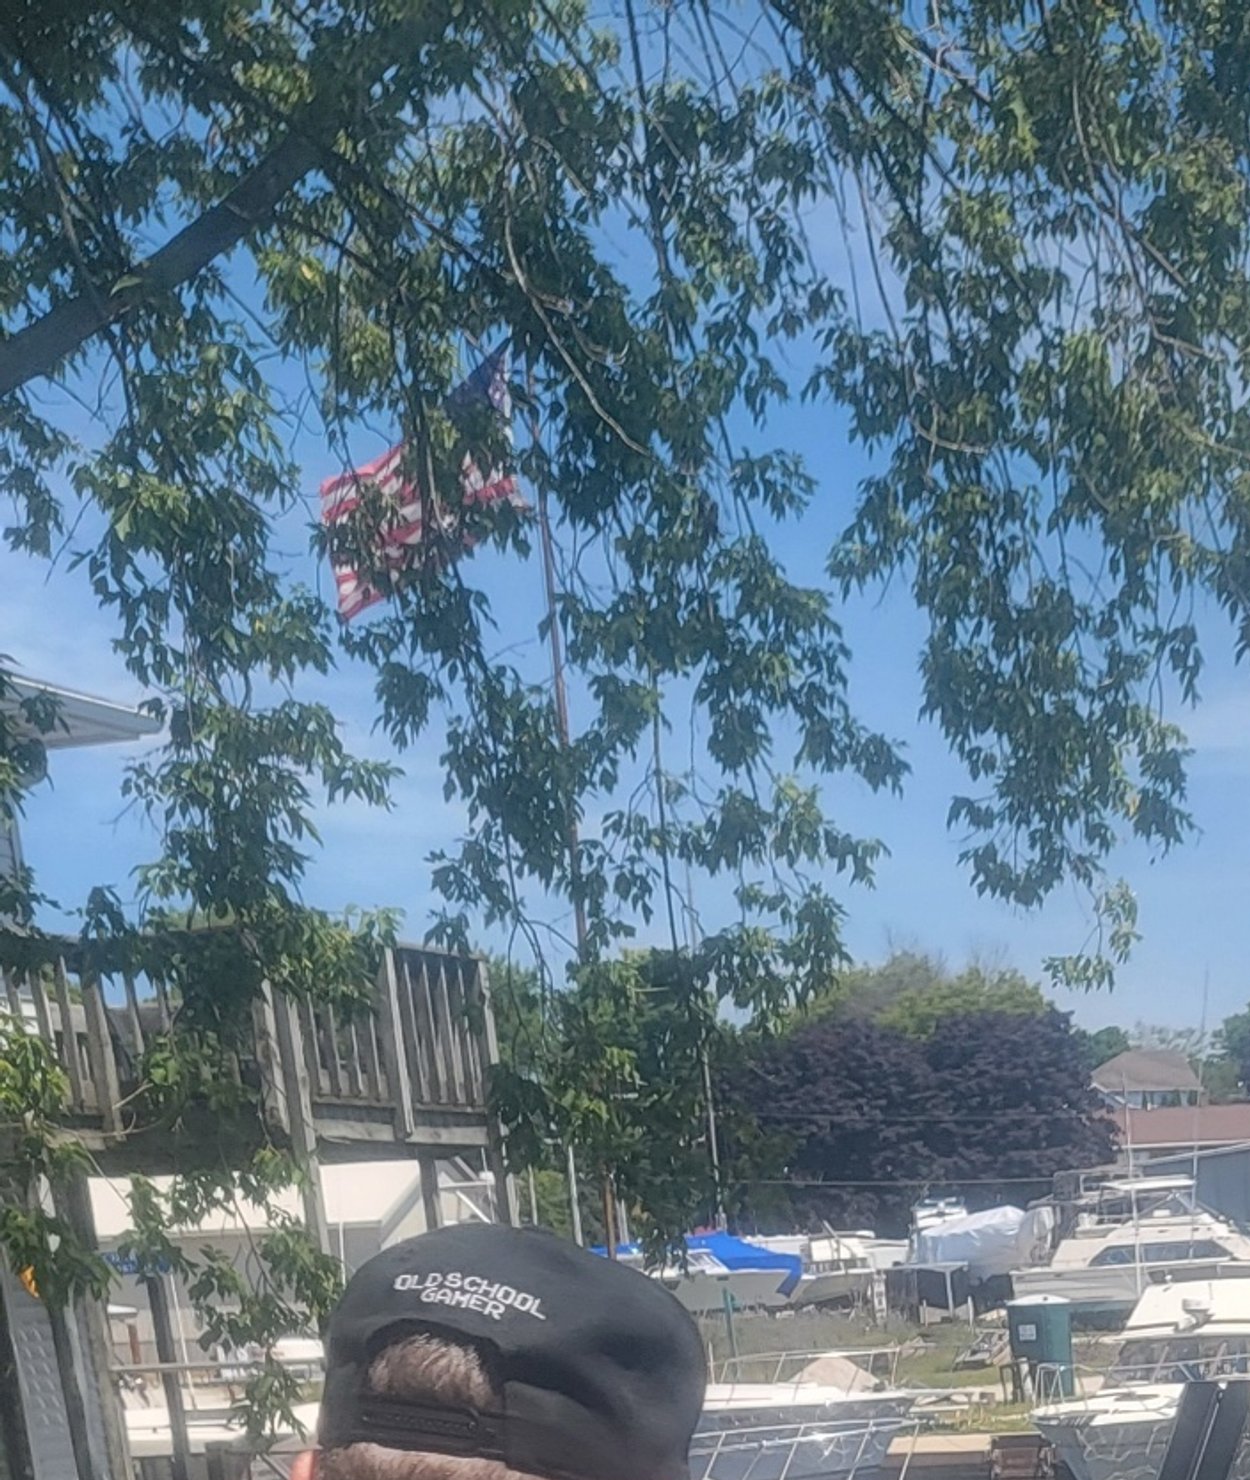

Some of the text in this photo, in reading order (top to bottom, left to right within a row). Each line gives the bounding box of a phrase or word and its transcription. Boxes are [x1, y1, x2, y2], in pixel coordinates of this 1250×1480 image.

[393, 1272, 546, 1320] OLD SCHOOL
[420, 1287, 505, 1320] GAMER
